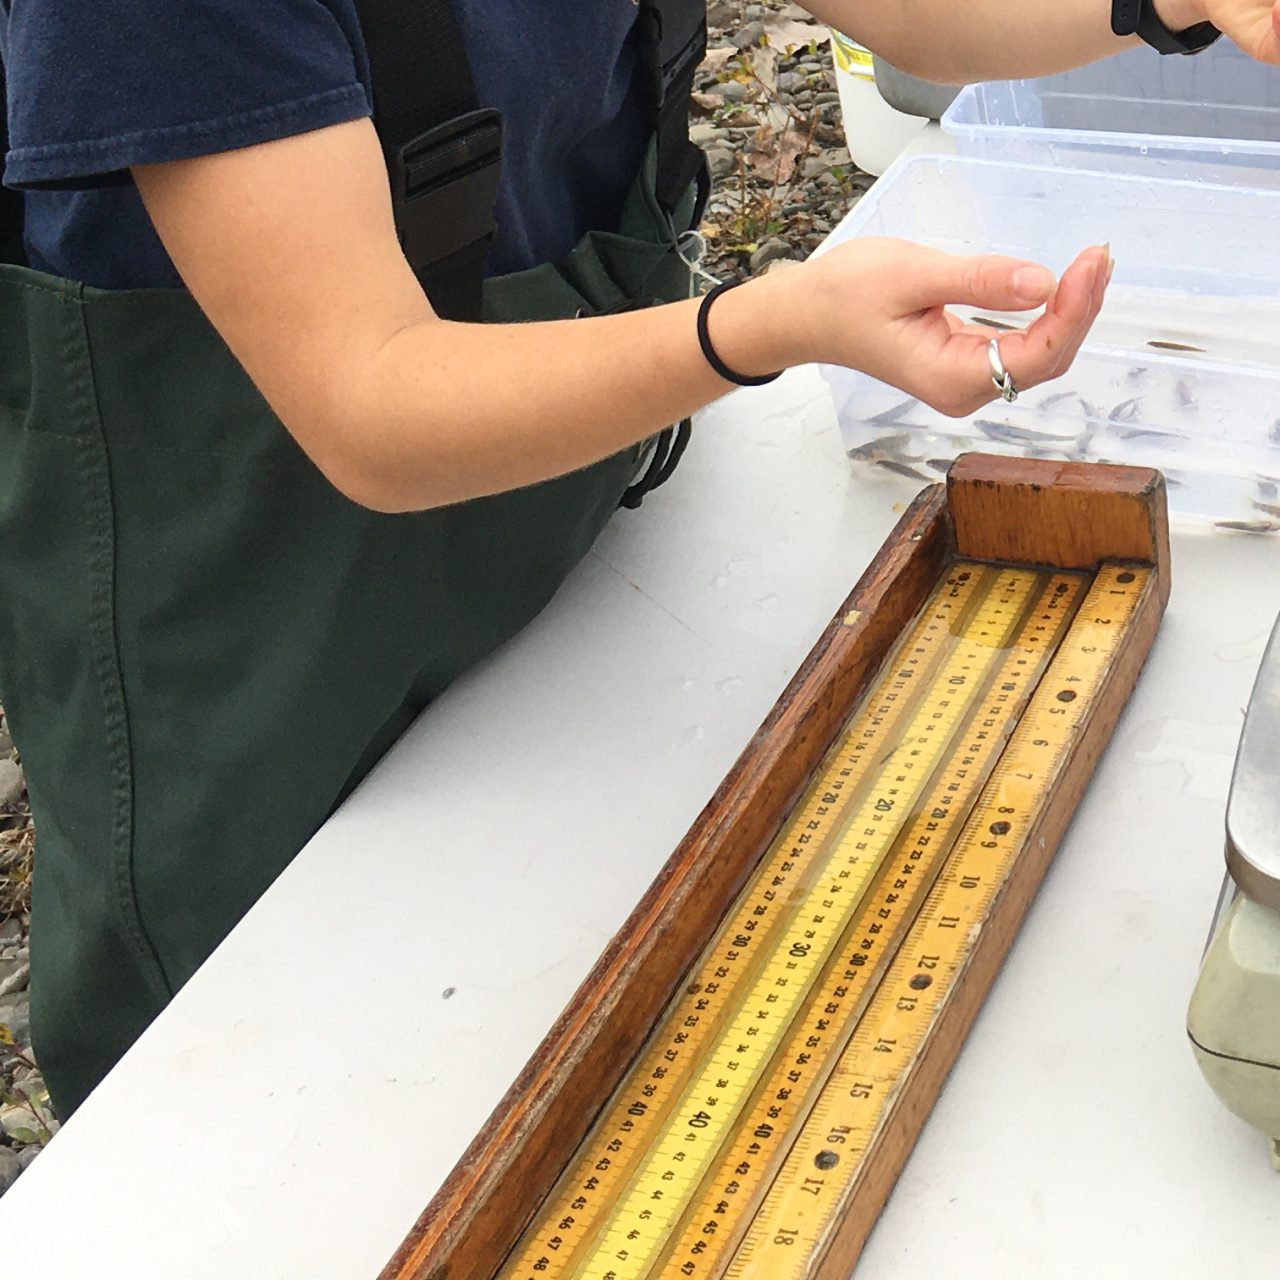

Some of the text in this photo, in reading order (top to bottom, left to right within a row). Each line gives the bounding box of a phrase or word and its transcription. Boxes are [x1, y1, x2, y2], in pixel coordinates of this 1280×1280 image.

[898, 669, 914, 678] 10
[948, 675, 966, 685] 10
[1001, 682, 1016, 691] 10
[885, 693, 898, 701] 12
[996, 694, 1009, 702] 11
[989, 706, 1002, 715] 12
[869, 716, 882, 725] 14
[983, 719, 995, 727] 13
[863, 730, 876, 738] 15
[976, 731, 988, 739] 14
[855, 742, 868, 750] 16
[969, 744, 982, 752] 15
[848, 755, 861, 764] 17
[962, 757, 975, 765] 16
[840, 768, 852, 776] 18
[956, 769, 968, 778] 17
[832, 781, 845, 790] 19
[947, 783, 960, 791] 18
[821, 792, 839, 804] 20
[940, 796, 953, 805] 19
[874, 798, 895, 811] 20
[997, 806, 1015, 814] 8
[816, 806, 829, 815] 21
[930, 808, 949, 819] 20
[806, 820, 820, 830] 22
[925, 822, 938, 831] 21
[798, 833, 812, 844] 23
[917, 836, 931, 846] 22
[789, 847, 803, 857] 24
[909, 850, 923, 860] 23
[780, 861, 794, 872] 25
[902, 864, 915, 874] 24
[771, 875, 785, 886] 26
[893, 878, 907, 889] 25
[959, 875, 980, 889] 10
[763, 890, 776, 901] 27
[885, 893, 899, 904] 26
[812, 915, 825, 923] 28
[878, 908, 891, 919] 27
[744, 920, 758, 931] 29
[938, 916, 960, 928] 11
[868, 923, 883, 934] 28
[804, 930, 816, 939] 29
[732, 934, 752, 947] 30
[860, 938, 874, 950] 29
[789, 942, 811, 957] 30
[725, 951, 739, 961] 31
[849, 953, 868, 966] 30
[917, 955, 940, 969] 12
[714, 966, 730, 978] 32
[843, 970, 857, 980] 31
[775, 977, 788, 987] 32
[704, 982, 720, 994] 33
[833, 986, 849, 998] 32
[766, 994, 779, 1003] 33
[896, 996, 918, 1011] 13
[694, 999, 710, 1010] 34
[824, 1002, 839, 1014] 33
[756, 1010, 769, 1019] 34
[684, 1015, 699, 1027] 35
[815, 1019, 830, 1031] 34
[746, 1027, 759, 1036] 35
[673, 1032, 689, 1044] 36
[806, 1036, 821, 1048] 35
[736, 1044, 749, 1053] 36
[873, 1038, 897, 1053] 14
[664, 1049, 678, 1062] 37
[796, 1053, 811, 1065] 36
[727, 1061, 739, 1071] 37
[652, 1066, 668, 1079] 38
[787, 1070, 802, 1083] 37
[716, 1079, 729, 1088] 38
[641, 1084, 657, 1097] 39
[776, 1088, 792, 1100] 38
[850, 1082, 873, 1099] 15
[706, 1096, 719, 1106] 39
[627, 1101, 648, 1116] 40
[767, 1106, 782, 1119] 39
[688, 1111, 711, 1128] 40
[619, 1120, 634, 1132] 41
[753, 1123, 774, 1138] 40
[684, 1132, 697, 1141] 41
[826, 1126, 853, 1144] 16
[607, 1139, 623, 1152] 42
[746, 1142, 761, 1155] 41
[673, 1152, 686, 1162] 42
[595, 1157, 611, 1171] 43
[735, 1161, 751, 1175] 42
[662, 1171, 675, 1181] 43
[583, 1176, 599, 1190] 44
[724, 1180, 740, 1194] 43
[800, 1177, 824, 1196] 17
[650, 1190, 663, 1200] 44
[571, 1196, 587, 1210] 45
[713, 1200, 729, 1214] 44
[639, 1209, 652, 1220] 45
[558, 1216, 575, 1229] 46
[702, 1220, 718, 1234] 45
[627, 1229, 640, 1240] 46
[773, 1228, 799, 1245] 18
[547, 1236, 563, 1251] 47
[691, 1240, 707, 1254] 46
[616, 1250, 629, 1261] 47
[533, 1256, 550, 1271] 48
[681, 1261, 695, 1276] 47
